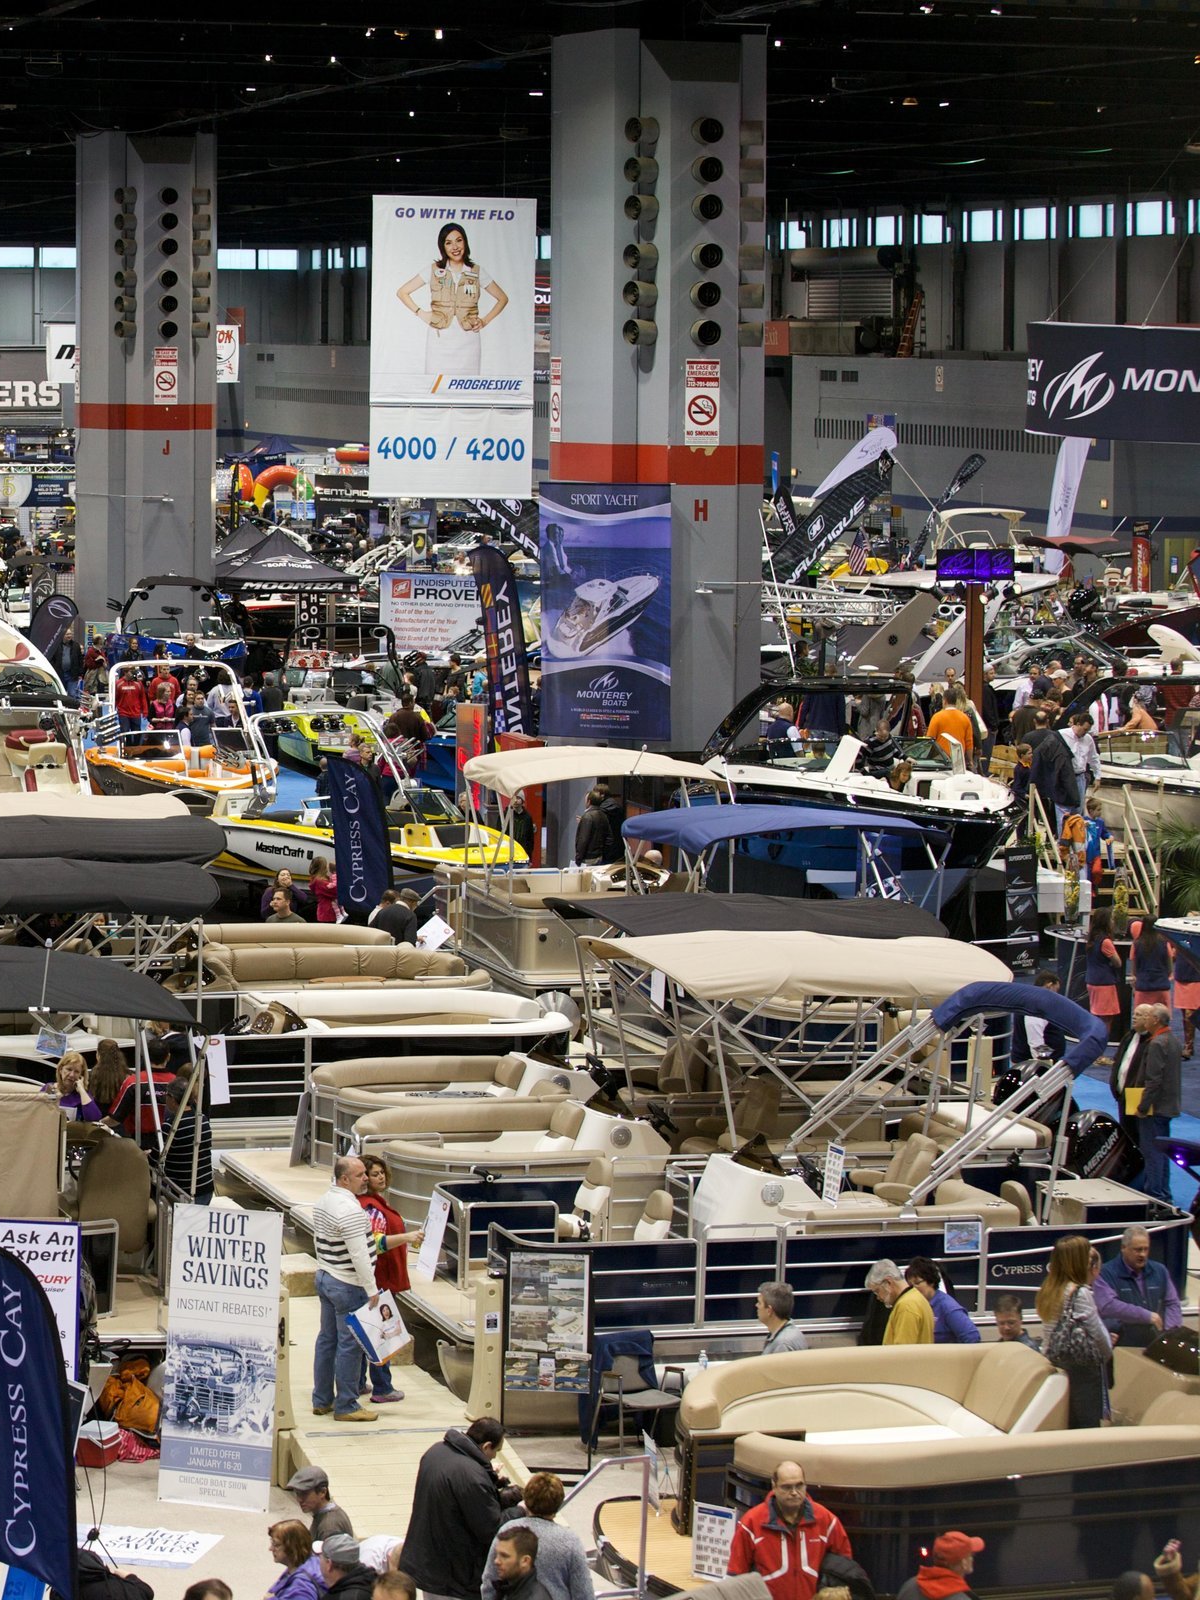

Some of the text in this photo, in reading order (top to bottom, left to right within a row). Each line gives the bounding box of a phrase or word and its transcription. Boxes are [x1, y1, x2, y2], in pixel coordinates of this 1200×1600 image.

[395, 208, 515, 221] GO WITH THE FLO
[448, 379, 523, 391] PROGRESSIVE
[1122, 367, 1200, 393] MON
[162, 439, 170, 455] J
[377, 436, 525, 461] 4000 / 4200
[2, 476, 17, 496] 5
[315, 488, 369, 497] CENTURIO
[570, 494, 638, 507] SPORT YACHT
[695, 500, 708, 522] H
[784, 497, 867, 585] NAUTIQUE
[241, 582, 344, 590] MOOMBA
[414, 579, 477, 588] UNDISPUTED
[577, 690, 632, 700] MONTEREY
[602, 699, 628, 707] BOATS
[343, 774, 367, 902] CYPRESS CAY
[256, 841, 304, 858] MasterCraft
[1009, 854, 1032, 862] SUPERSPORTS
[1083, 1129, 1121, 1176] MERCURY
[208, 1211, 249, 1237] HOT
[1, 1229, 75, 1246] Ask An
[187, 1235, 266, 1264] WINTER
[182, 1260, 269, 1290] SAVINGS
[991, 1263, 1043, 1279] CYPRESS
[35, 1274, 72, 1285] CURY
[177, 1297, 220, 1312] INSTANT
[0, 1280, 37, 1557] CYPRESS CAY
[190, 1446, 240, 1460] LIMITED OFFER
[187, 1458, 242, 1471] JANUARY 16-20
[179, 1475, 248, 1491] CHICAGO BOAT SHOW
[199, 1488, 227, 1498] SPECIAL
[118, 1535, 200, 1548] WINTER
[145, 1529, 189, 1539] HOT
[105, 1539, 197, 1554] SAVINGS
